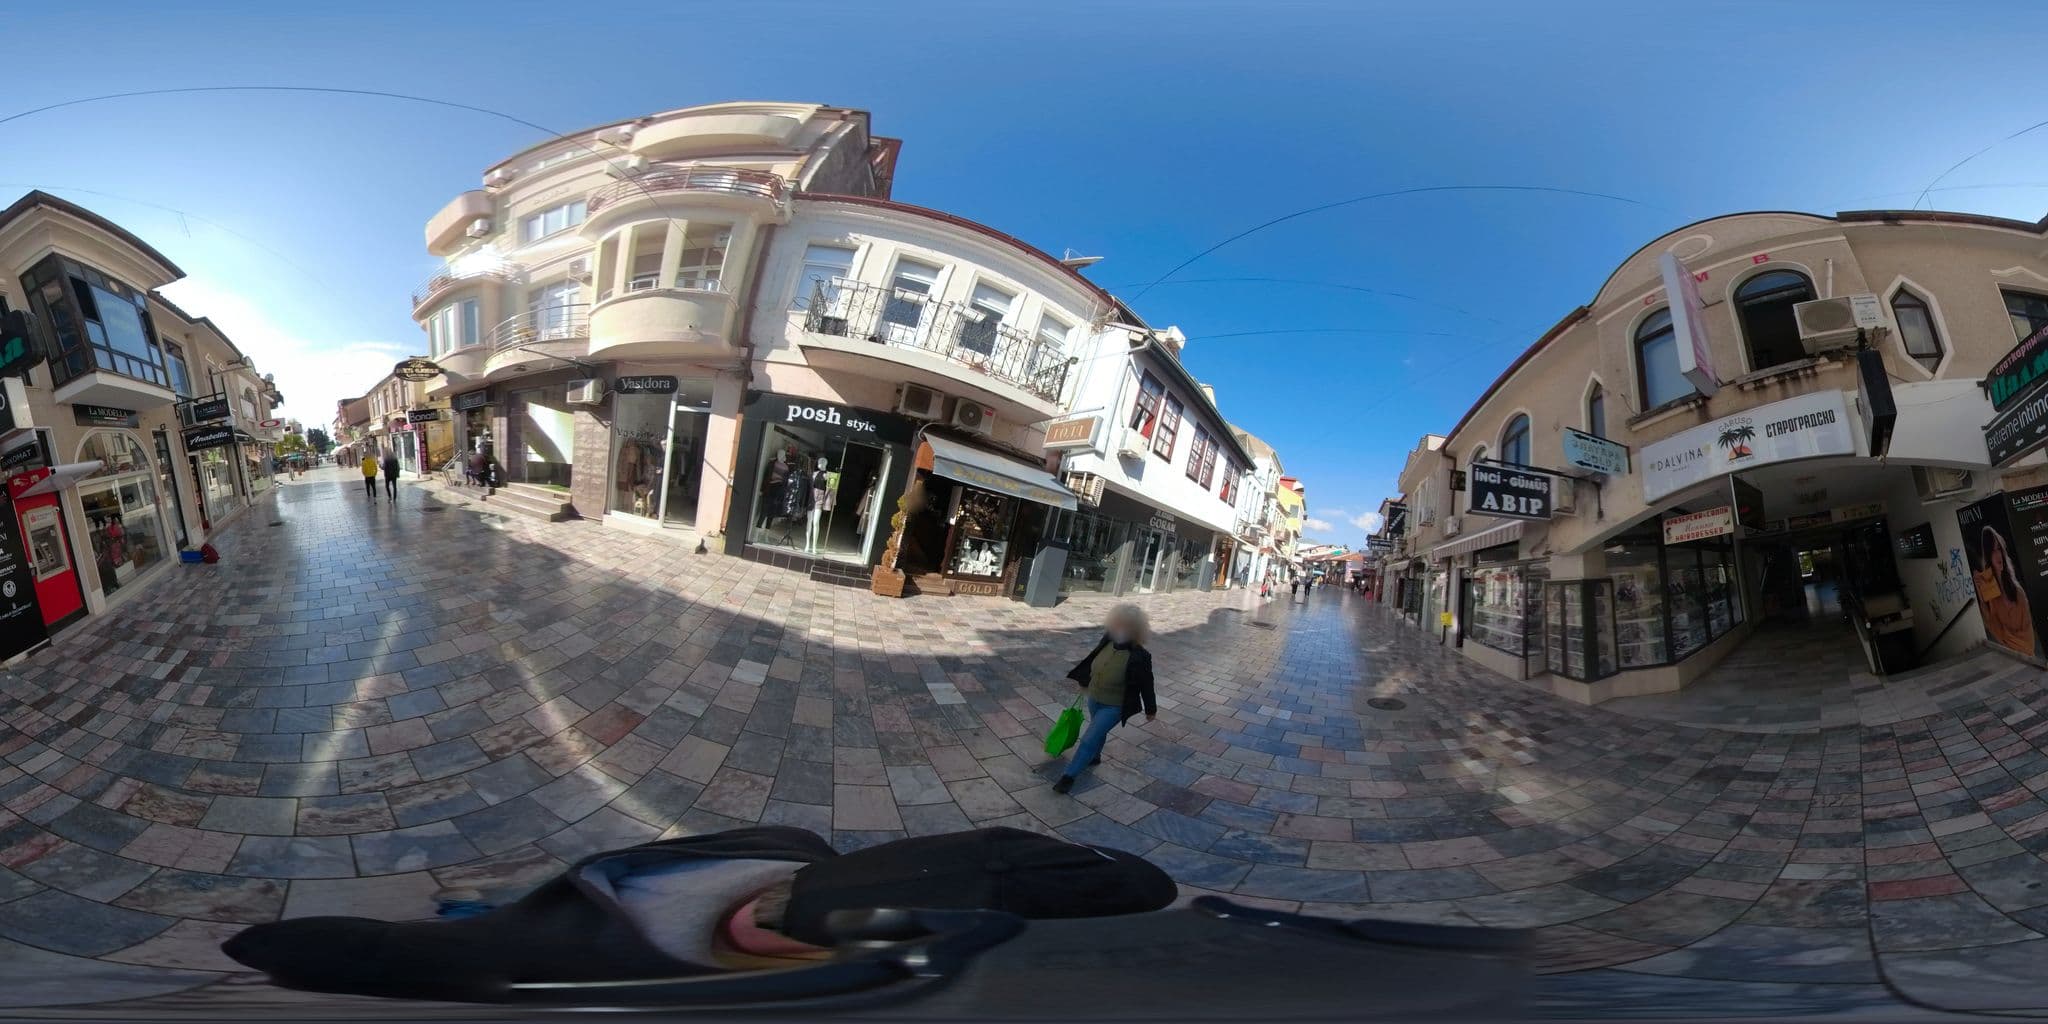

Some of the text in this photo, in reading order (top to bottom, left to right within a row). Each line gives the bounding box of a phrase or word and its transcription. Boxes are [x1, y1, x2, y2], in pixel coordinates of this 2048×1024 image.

[622, 378, 671, 390] Vasidora
[786, 404, 877, 432] posh style
[1765, 409, 1836, 438] СТАРОГРАДСКО
[1657, 447, 1703, 471] DALVINA
[958, 583, 992, 594] GOLD
